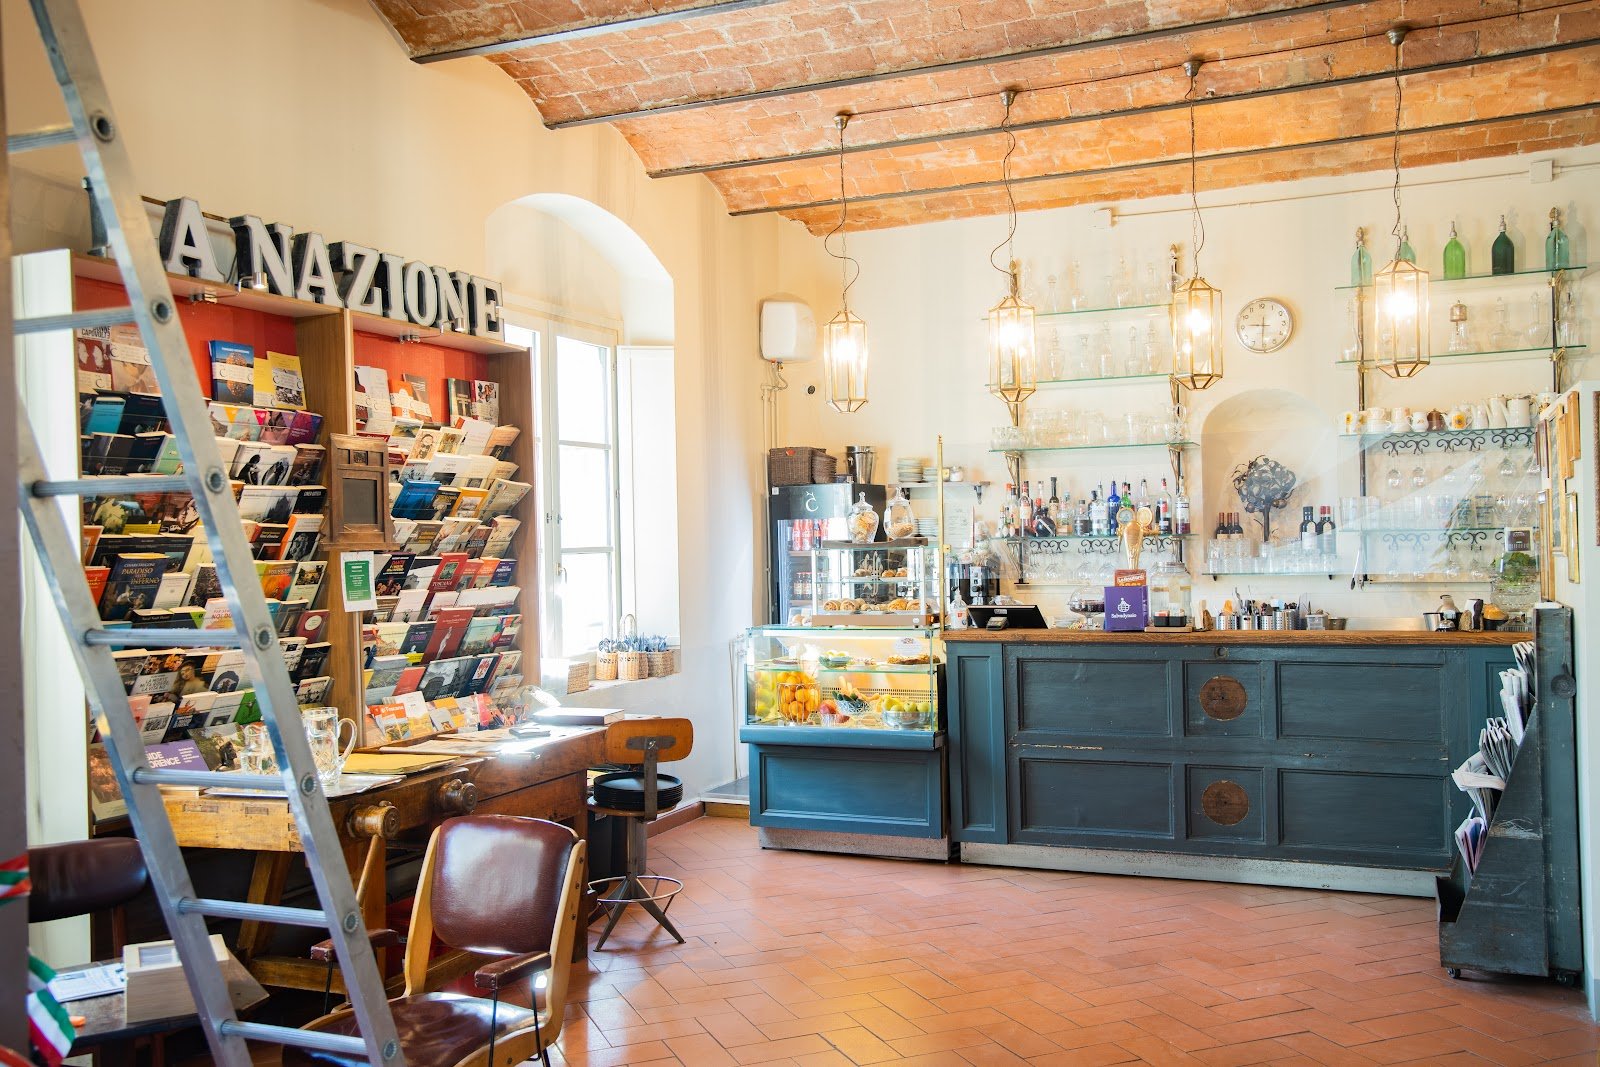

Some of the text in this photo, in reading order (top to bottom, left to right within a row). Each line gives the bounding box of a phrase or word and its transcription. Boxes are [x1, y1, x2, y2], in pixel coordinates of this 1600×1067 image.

[229, 214, 505, 342] NAZIONE
[122, 567, 153, 575] PARADISO
[131, 577, 160, 585] INFERNO
[149, 756, 181, 768] ORENCE
